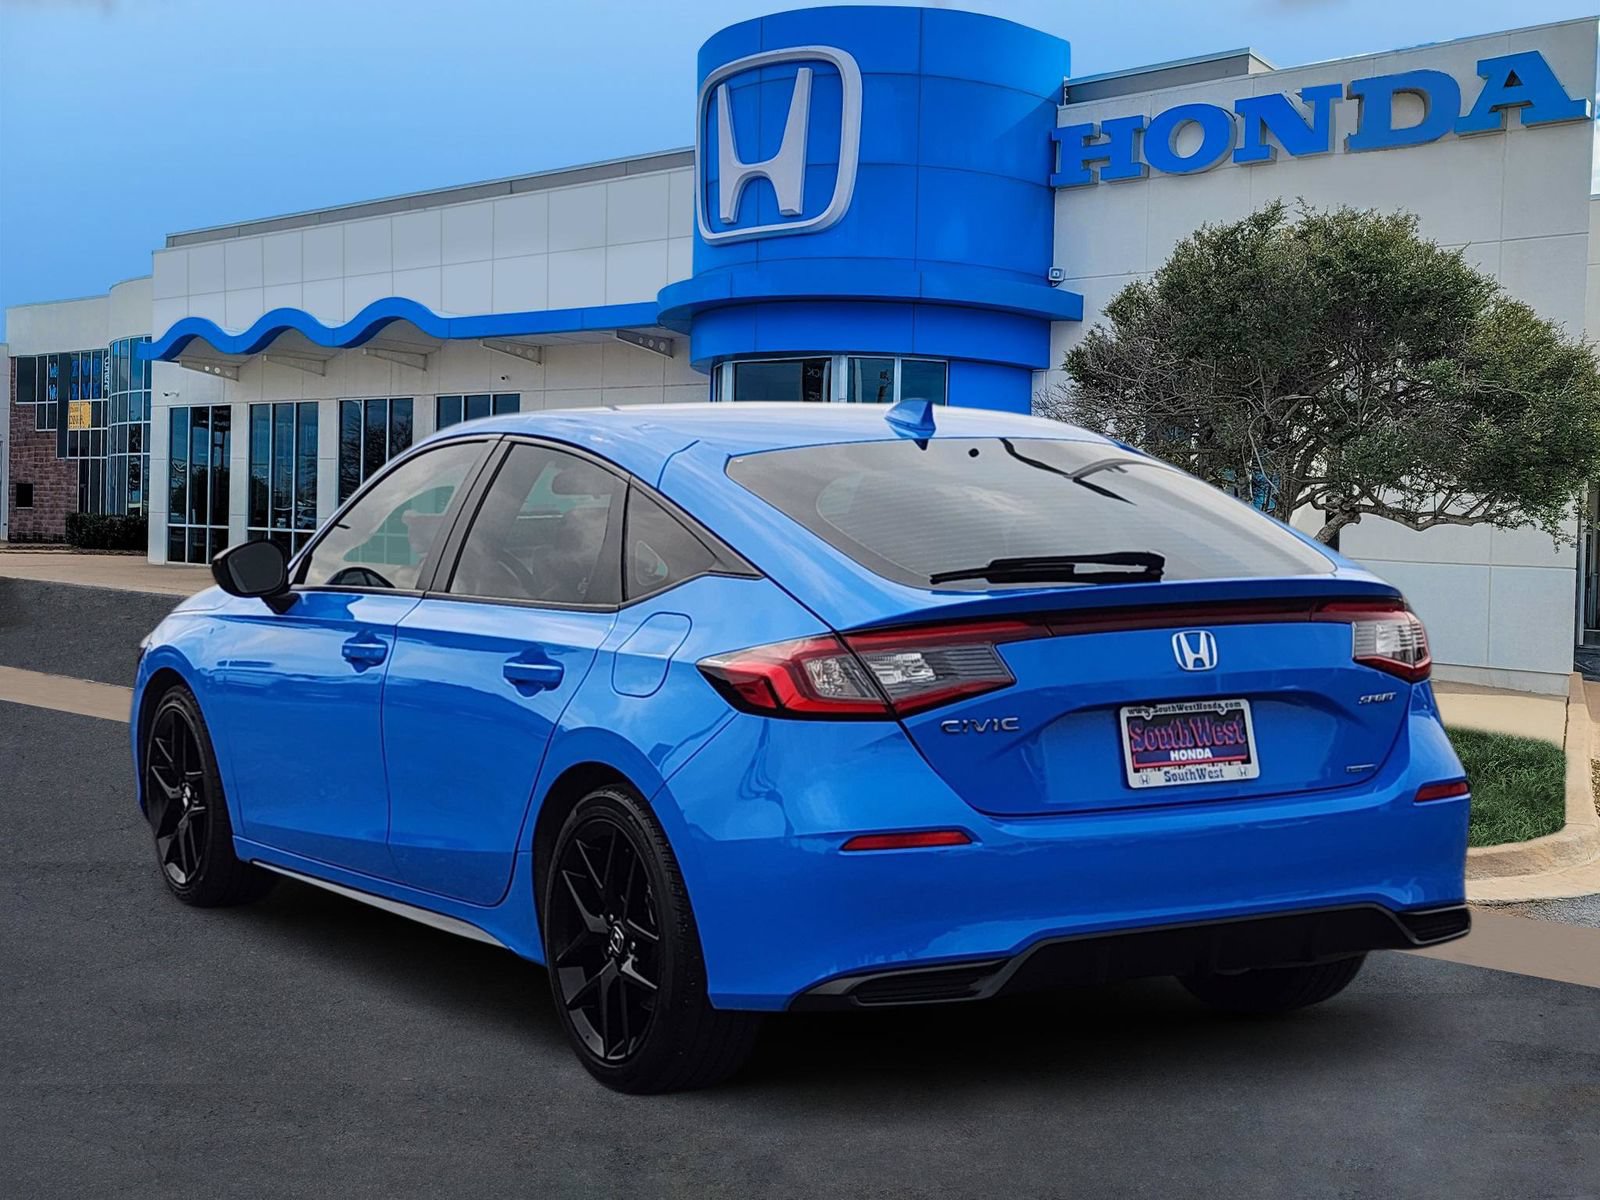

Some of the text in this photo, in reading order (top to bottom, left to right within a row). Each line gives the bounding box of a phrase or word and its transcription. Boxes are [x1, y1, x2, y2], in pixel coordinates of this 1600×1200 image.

[1050, 50, 1592, 188] HONDA
[1358, 691, 1397, 704] SPORT
[940, 717, 1019, 733] CIVIC
[1128, 716, 1246, 751] SouthWest
[1169, 747, 1213, 761] HONDA
[1163, 768, 1225, 783] SouthWest
